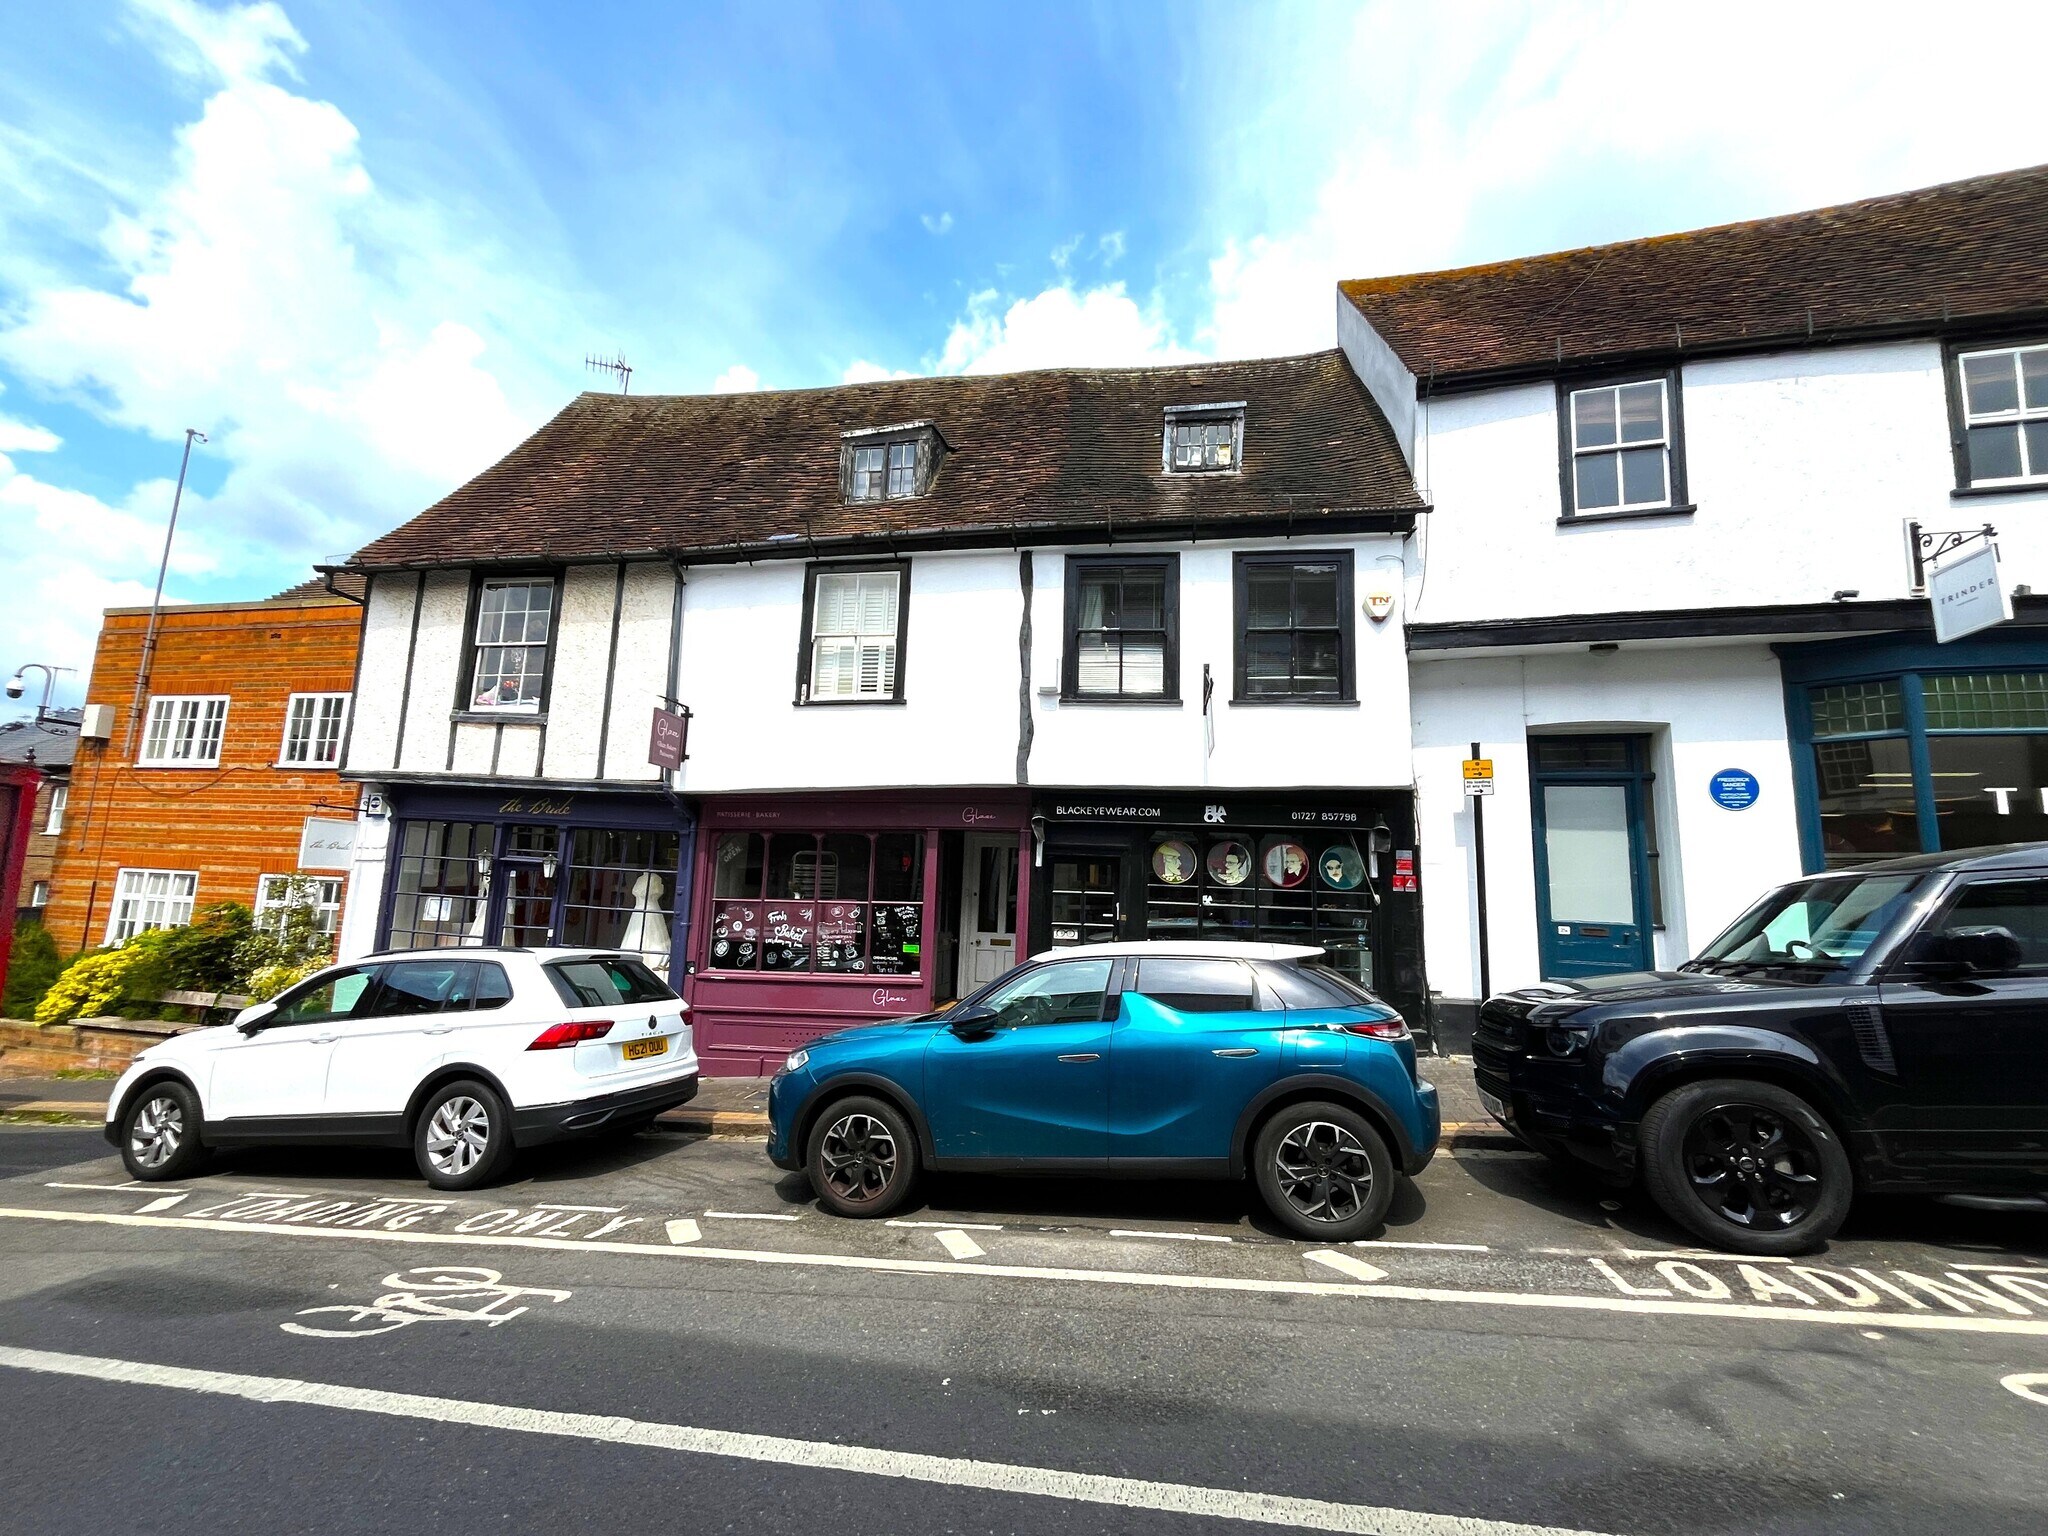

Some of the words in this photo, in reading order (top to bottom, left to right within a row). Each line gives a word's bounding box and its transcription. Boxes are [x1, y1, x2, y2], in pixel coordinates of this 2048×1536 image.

[1941, 578, 1995, 605] TRINDER
[528, 795, 575, 815] Bride
[1056, 806, 1161, 817] BLACKEYEWEAR.COM
[1291, 811, 1316, 820] 01727
[1321, 812, 1357, 821] 857798
[774, 923, 807, 942] Baked
[628, 1043, 648, 1057] HG21
[183, 1197, 448, 1230] LOADING
[454, 1207, 643, 1239] ONLY
